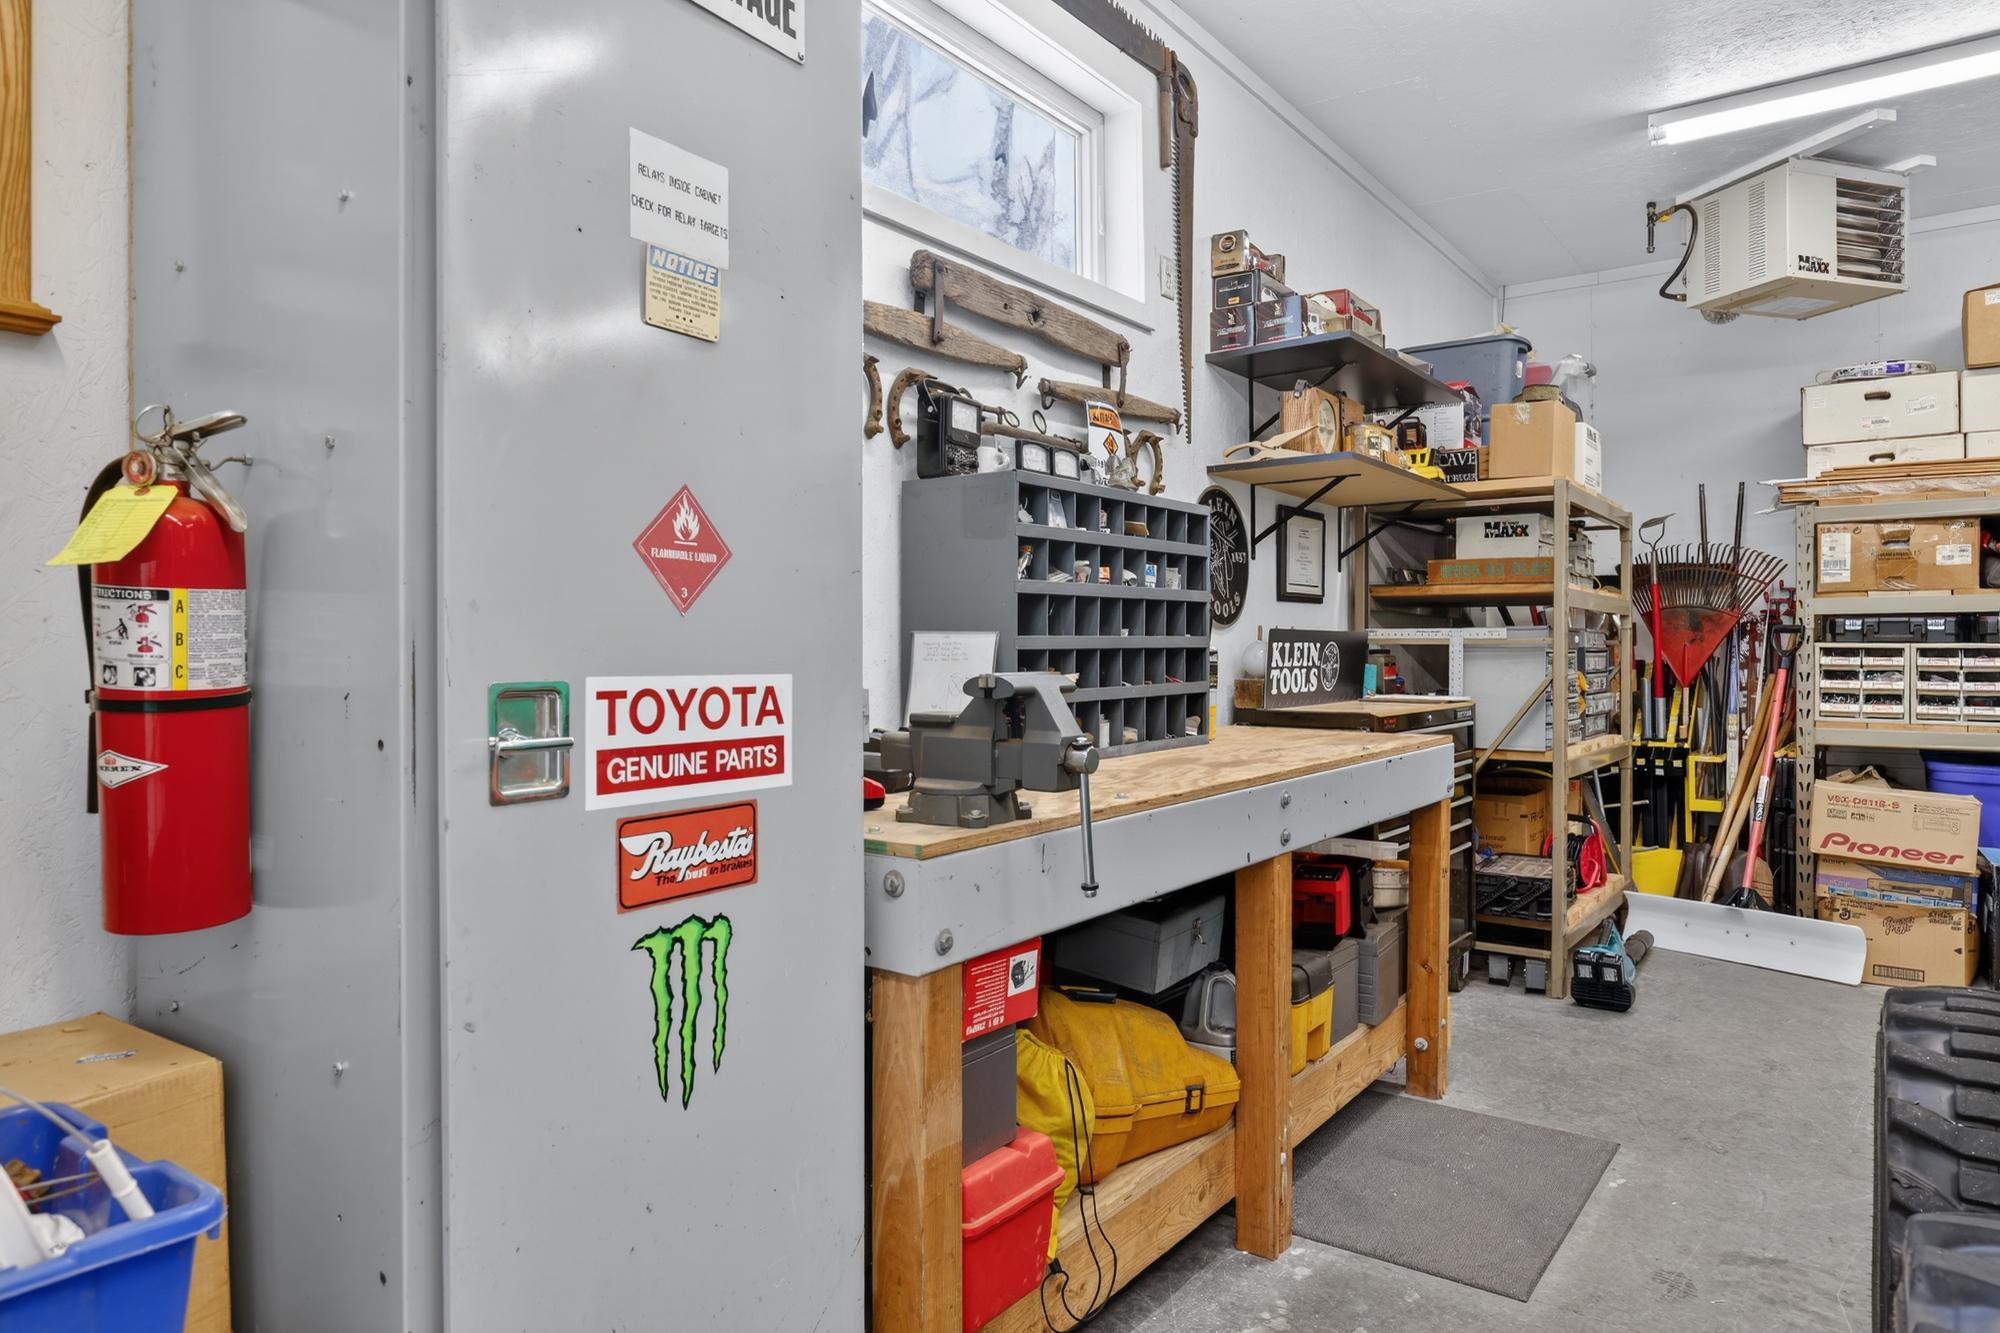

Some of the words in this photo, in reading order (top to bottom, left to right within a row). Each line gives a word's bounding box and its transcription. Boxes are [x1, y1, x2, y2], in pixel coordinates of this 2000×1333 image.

[638, 163, 665, 183] RELAYS
[669, 175, 691, 194] INSIDE
[695, 186, 721, 205] CABINET
[632, 194, 653, 212] CHECK
[658, 204, 671, 218] FOR
[675, 210, 696, 227] RELAY
[700, 219, 728, 240] TARGETS
[651, 248, 716, 284] NOTICE
[1208, 497, 1238, 526] LEIN
[1484, 521, 1529, 538] MAXX
[175, 600, 184, 613] A
[681, 587, 688, 598] 3
[175, 632, 184, 646] B
[1271, 642, 1320, 668] KLEIN
[175, 665, 183, 679] C
[1270, 668, 1318, 695] TOOLS
[596, 686, 784, 736] TOYOTA
[606, 751, 707, 784] GENUINE
[715, 744, 777, 772] PARTS
[1820, 832, 1964, 865] Pioneer
